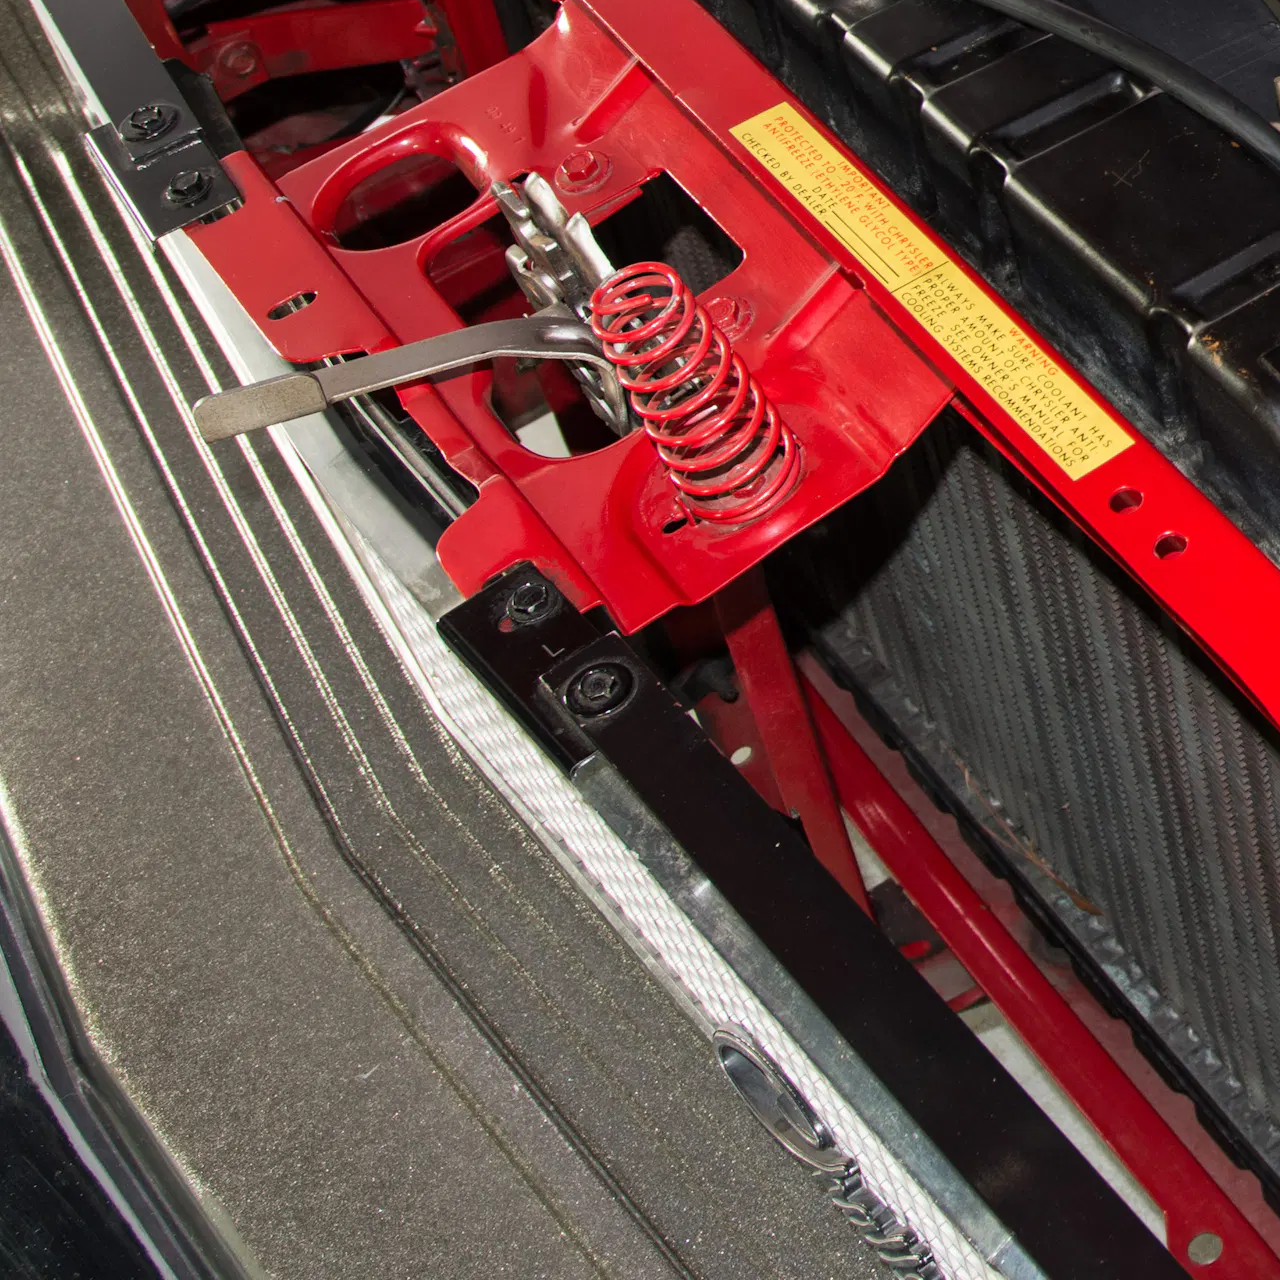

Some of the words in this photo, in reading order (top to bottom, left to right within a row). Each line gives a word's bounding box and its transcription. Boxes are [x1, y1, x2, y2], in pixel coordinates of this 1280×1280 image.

[741, 132, 781, 169] CHECKED
[779, 170, 794, 182] BY
[792, 183, 827, 215] DEALER
[762, 121, 813, 169] ANTIFREEZE
[810, 169, 860, 215] (ETHYLENE
[858, 215, 896, 249] GLYCOL
[892, 249, 923, 276] TYPE)
[774, 116, 823, 161] PROTECTED
[821, 162, 836, 173] TO
[863, 203, 890, 226] WITH
[886, 226, 933, 269] CHRYSLER
[812, 186, 837, 208] DATE
[837, 160, 890, 209] IMPORTANT
[900, 292, 944, 333] COOLING
[942, 334, 983, 372] SYSTEMS
[981, 374, 1076, 466] RECOMMENDATIONS
[911, 284, 946, 317] FREEZE
[950, 324, 970, 340] SEE
[970, 344, 1019, 390] OWNER'S
[1019, 394, 1065, 437] MANUAL
[1066, 441, 1089, 462] FOR
[922, 278, 960, 312] PROPER
[959, 315, 1004, 357] AMOUNT
[1003, 359, 1020, 373] OF
[1019, 375, 1070, 423] CHRYSLER
[933, 271, 975, 310] ALWAYS
[975, 313, 1006, 340] MAKE
[1006, 345, 1035, 369] SURE
[1035, 374, 1087, 422] COOLANT
[1088, 426, 1113, 447] HAS
[1007, 327, 1059, 376] WARNING
